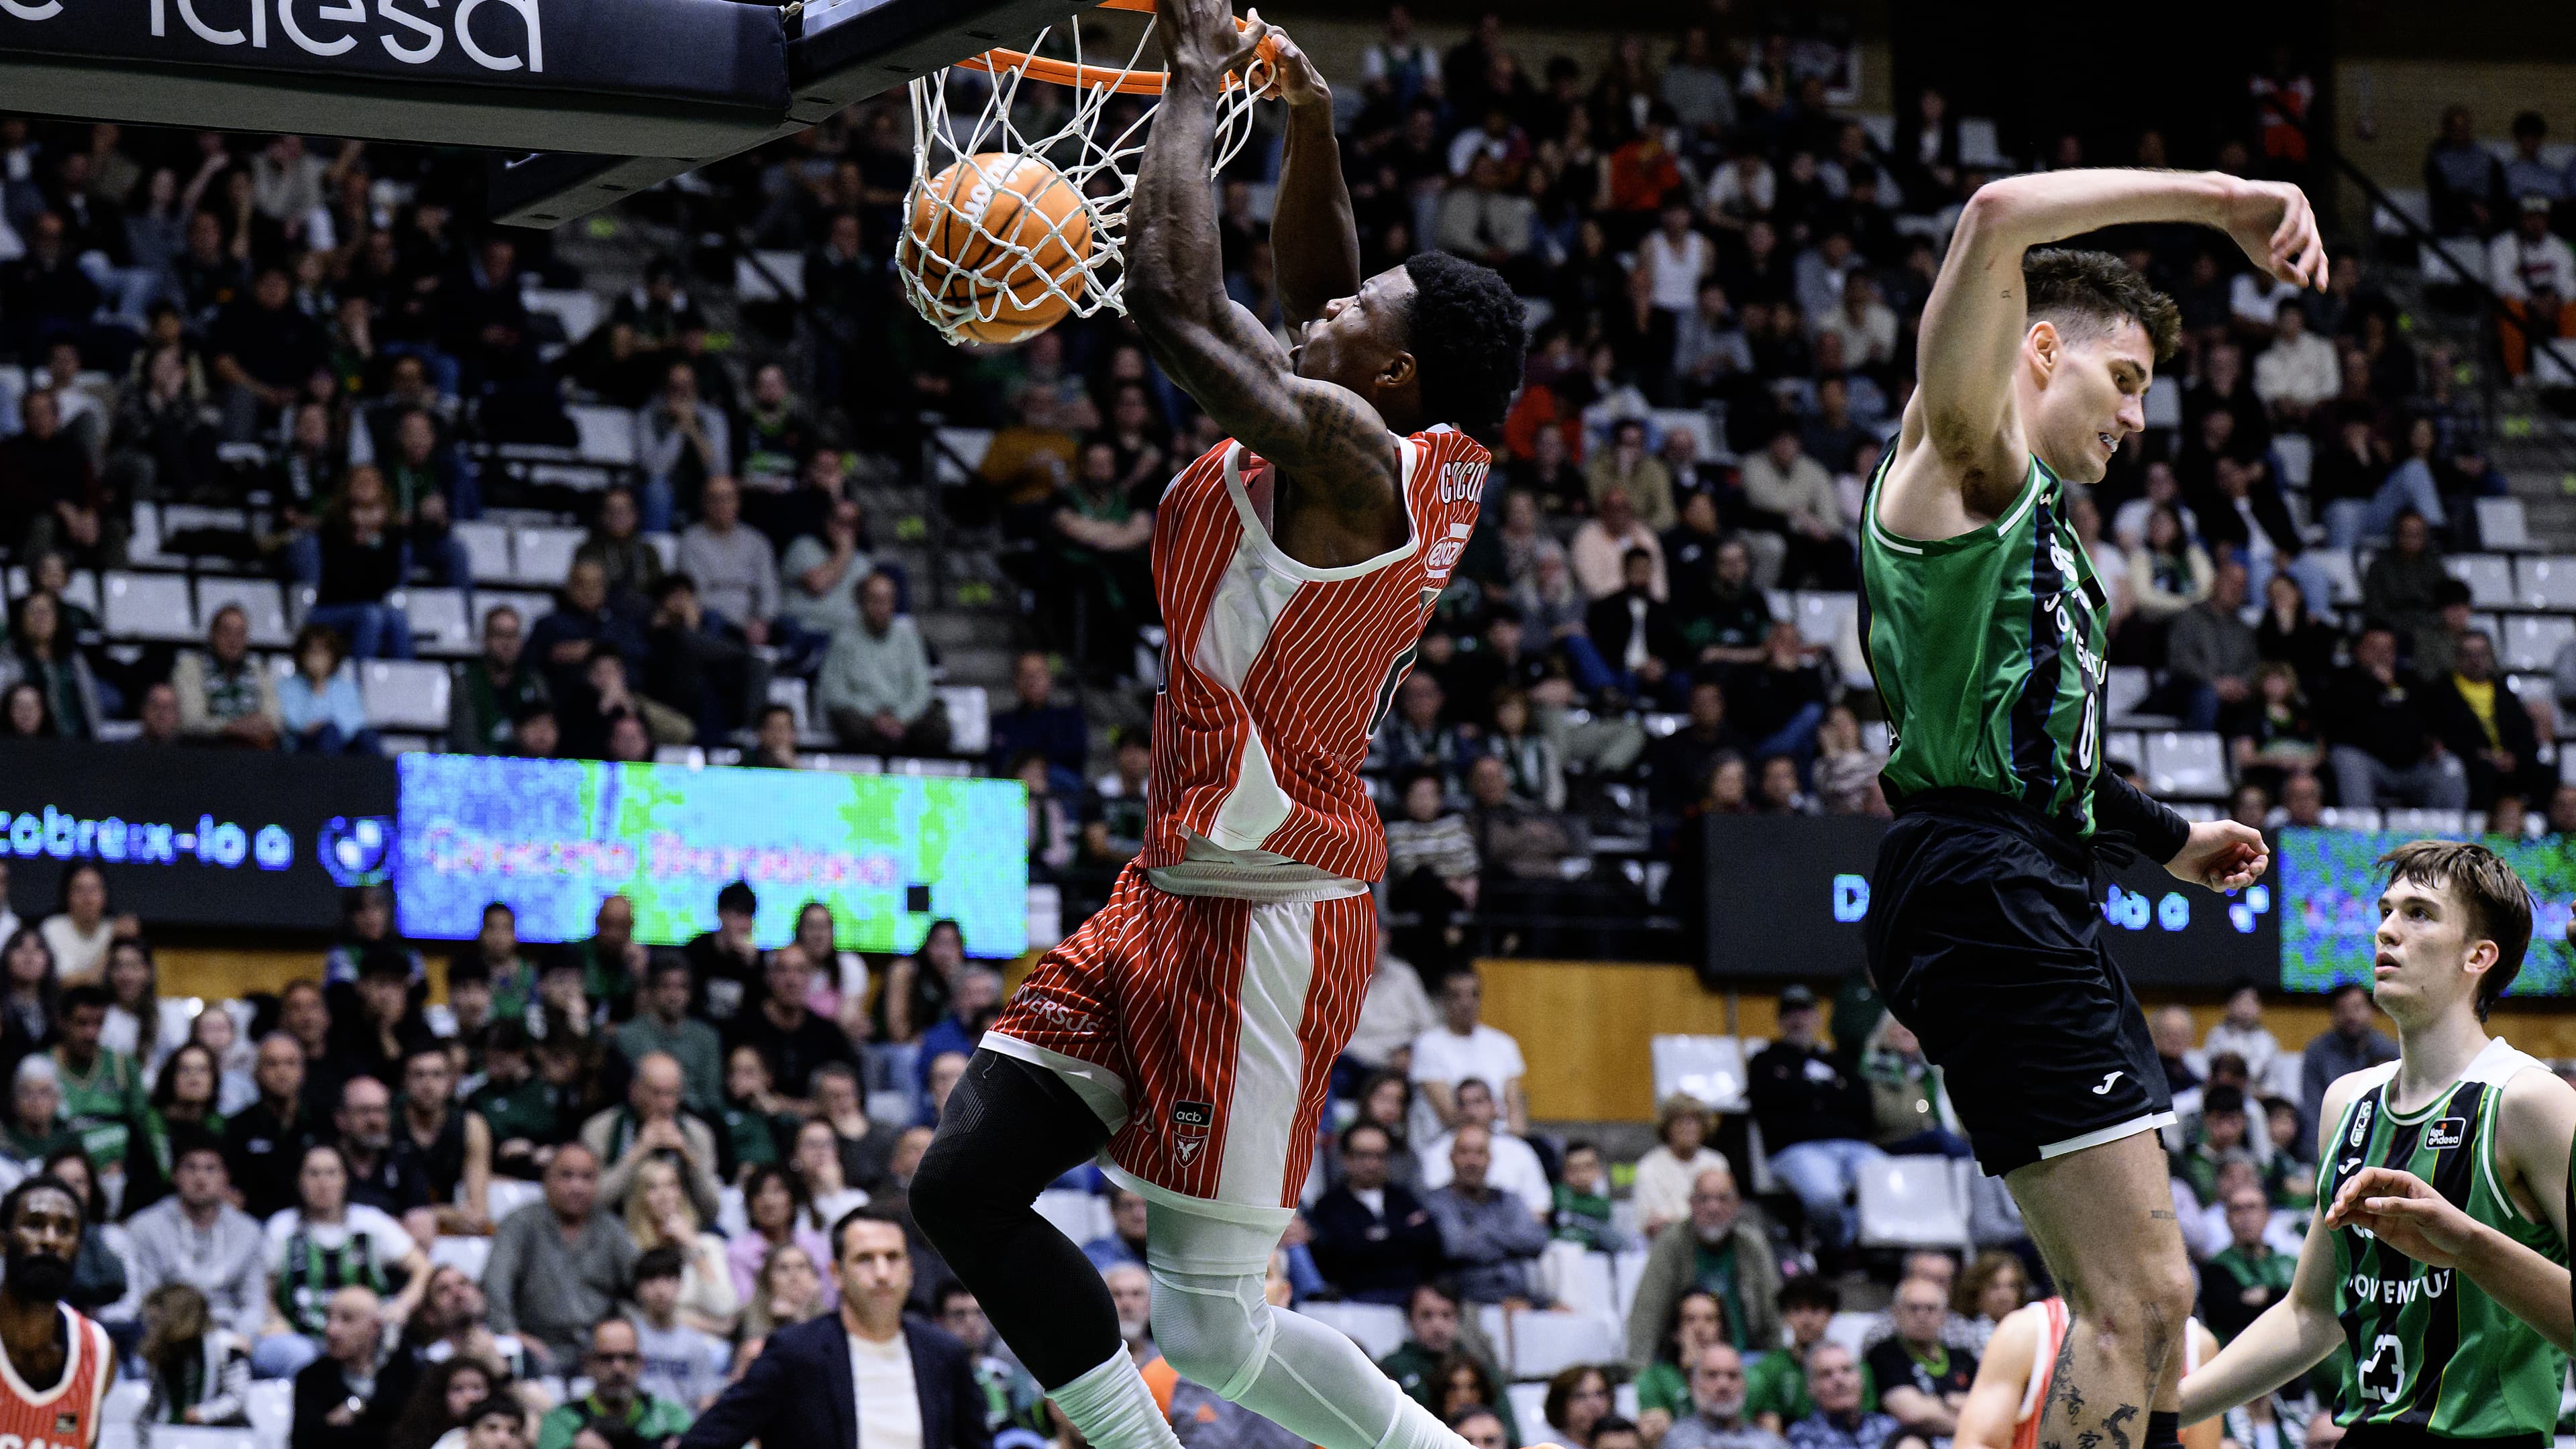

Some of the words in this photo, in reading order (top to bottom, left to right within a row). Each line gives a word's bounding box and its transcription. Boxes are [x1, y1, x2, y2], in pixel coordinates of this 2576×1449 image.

[1176, 1111, 1201, 1122] acb
[2428, 1135, 2459, 1145] endesa
[2358, 1333, 2406, 1405] 23
